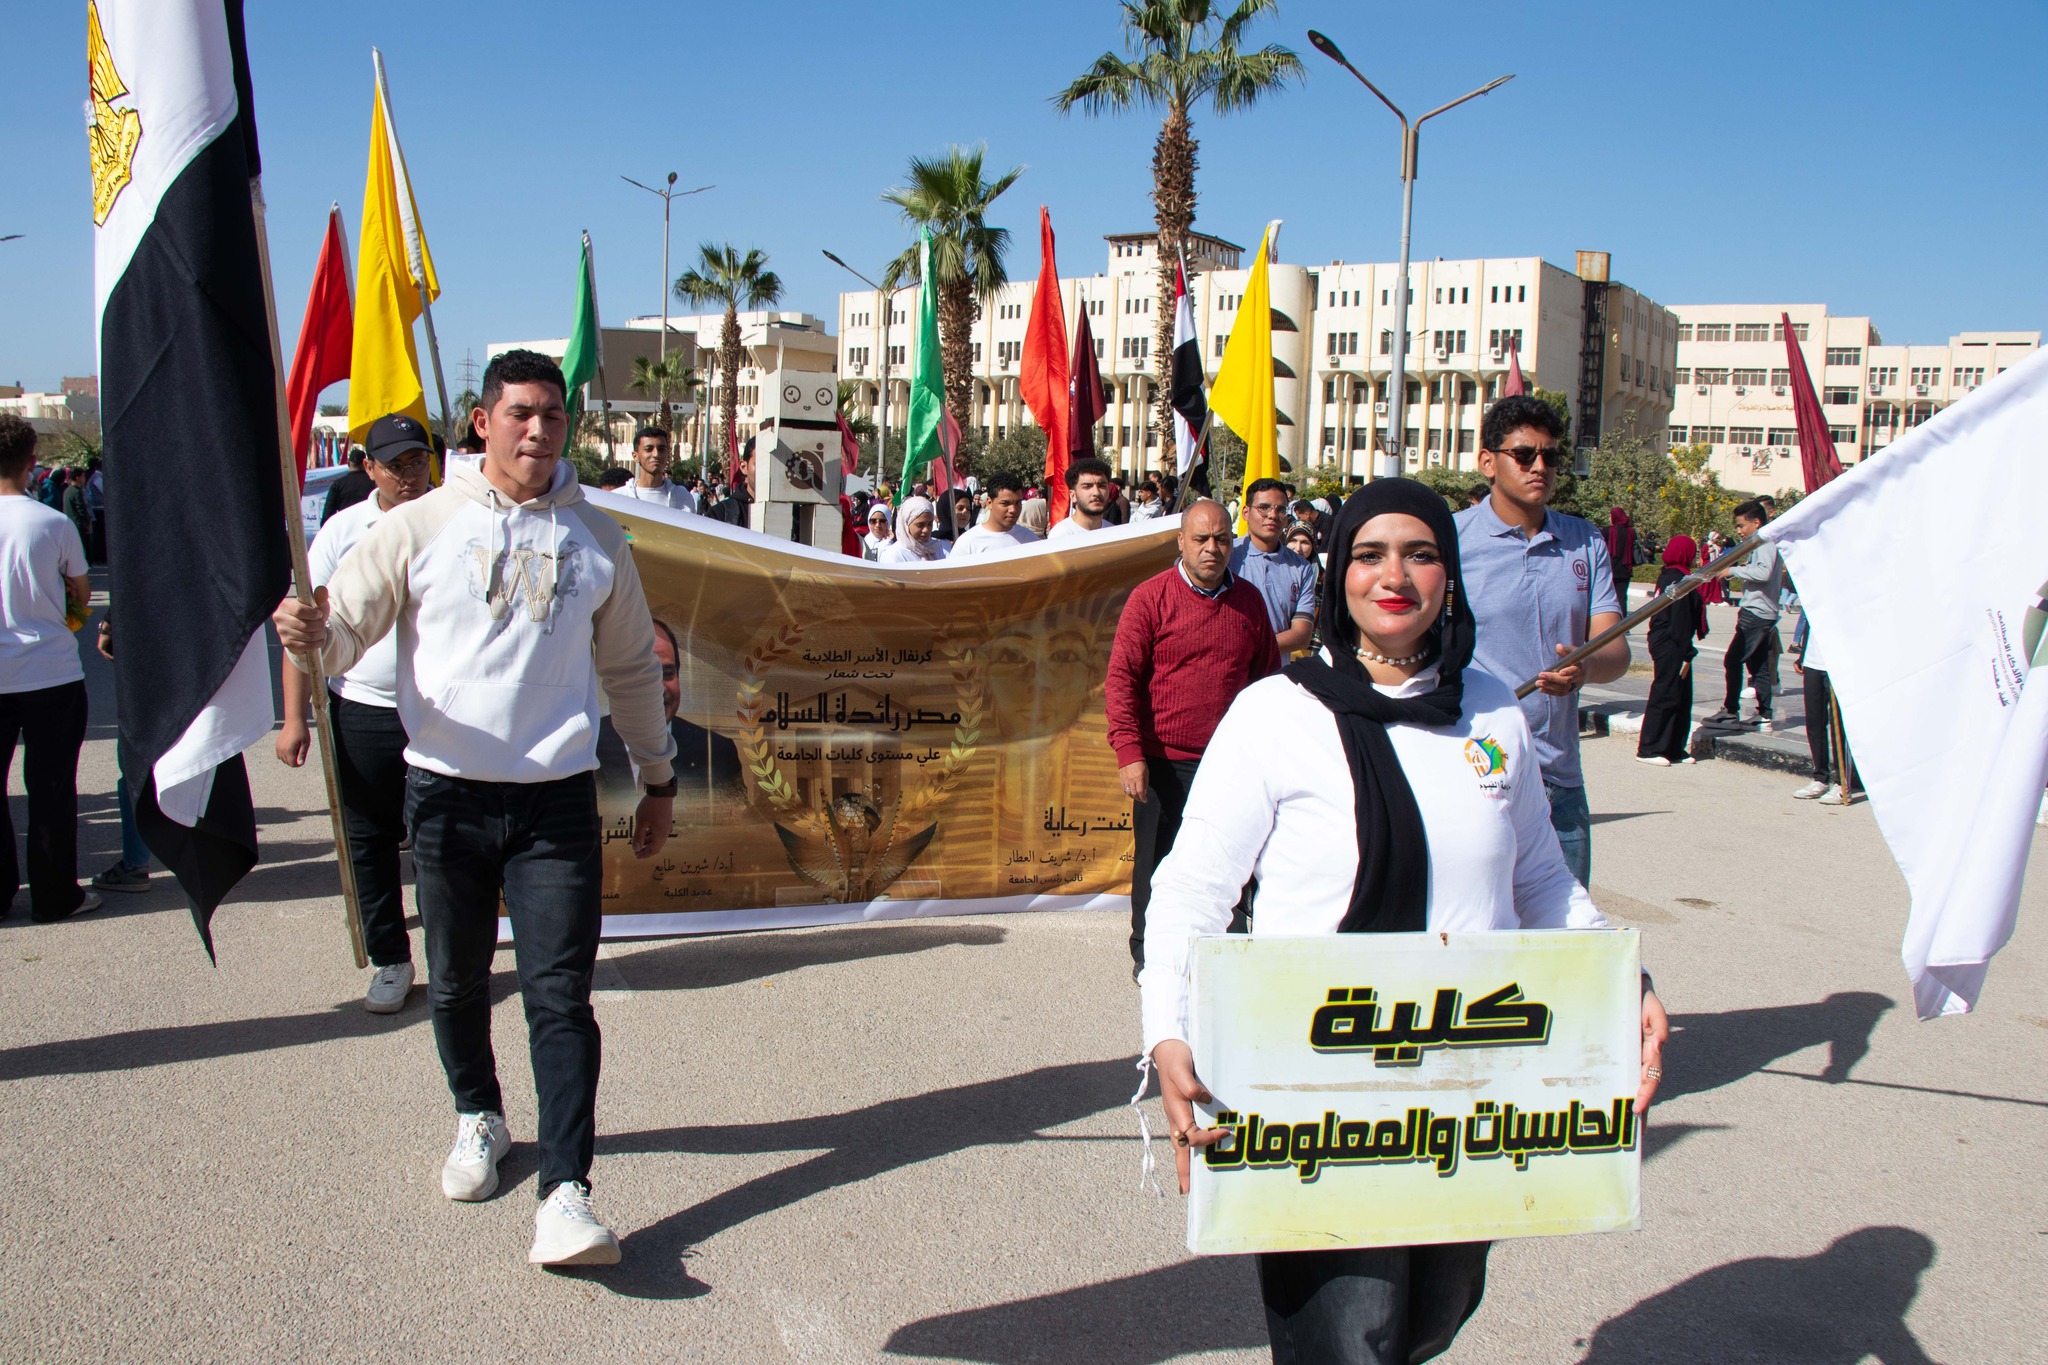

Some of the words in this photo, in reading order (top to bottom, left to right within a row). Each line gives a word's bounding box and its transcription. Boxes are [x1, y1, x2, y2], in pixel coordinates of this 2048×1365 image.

[802, 648, 851, 663] الطلابية
[854, 647, 889, 664] الأسر
[892, 649, 932, 664] كرنفال
[825, 669, 859, 680] شعار
[863, 669, 895, 679] تحت
[1998, 691, 2010, 707] كلية
[758, 692, 830, 730] السلام
[835, 693, 900, 731] رائدة
[902, 708, 961, 731] مصر
[777, 747, 822, 764] الجامعة
[826, 748, 863, 764] كليات
[865, 749, 913, 764] مستوى
[1044, 807, 1087, 837] رعاية
[680, 858, 709, 874] شيرين
[1005, 850, 1035, 866] العطار
[1039, 851, 1071, 867] شريف
[1009, 875, 1039, 885] الجامعة
[1040, 874, 1062, 885] رئيس
[1064, 873, 1083, 884] نائب
[664, 888, 689, 898] الكلية
[691, 887, 713, 897] عميد
[1309, 982, 1554, 1067] كلية
[1464, 1098, 1637, 1170] الحاسبات
[1204, 1109, 1461, 1184] والمعلومات
